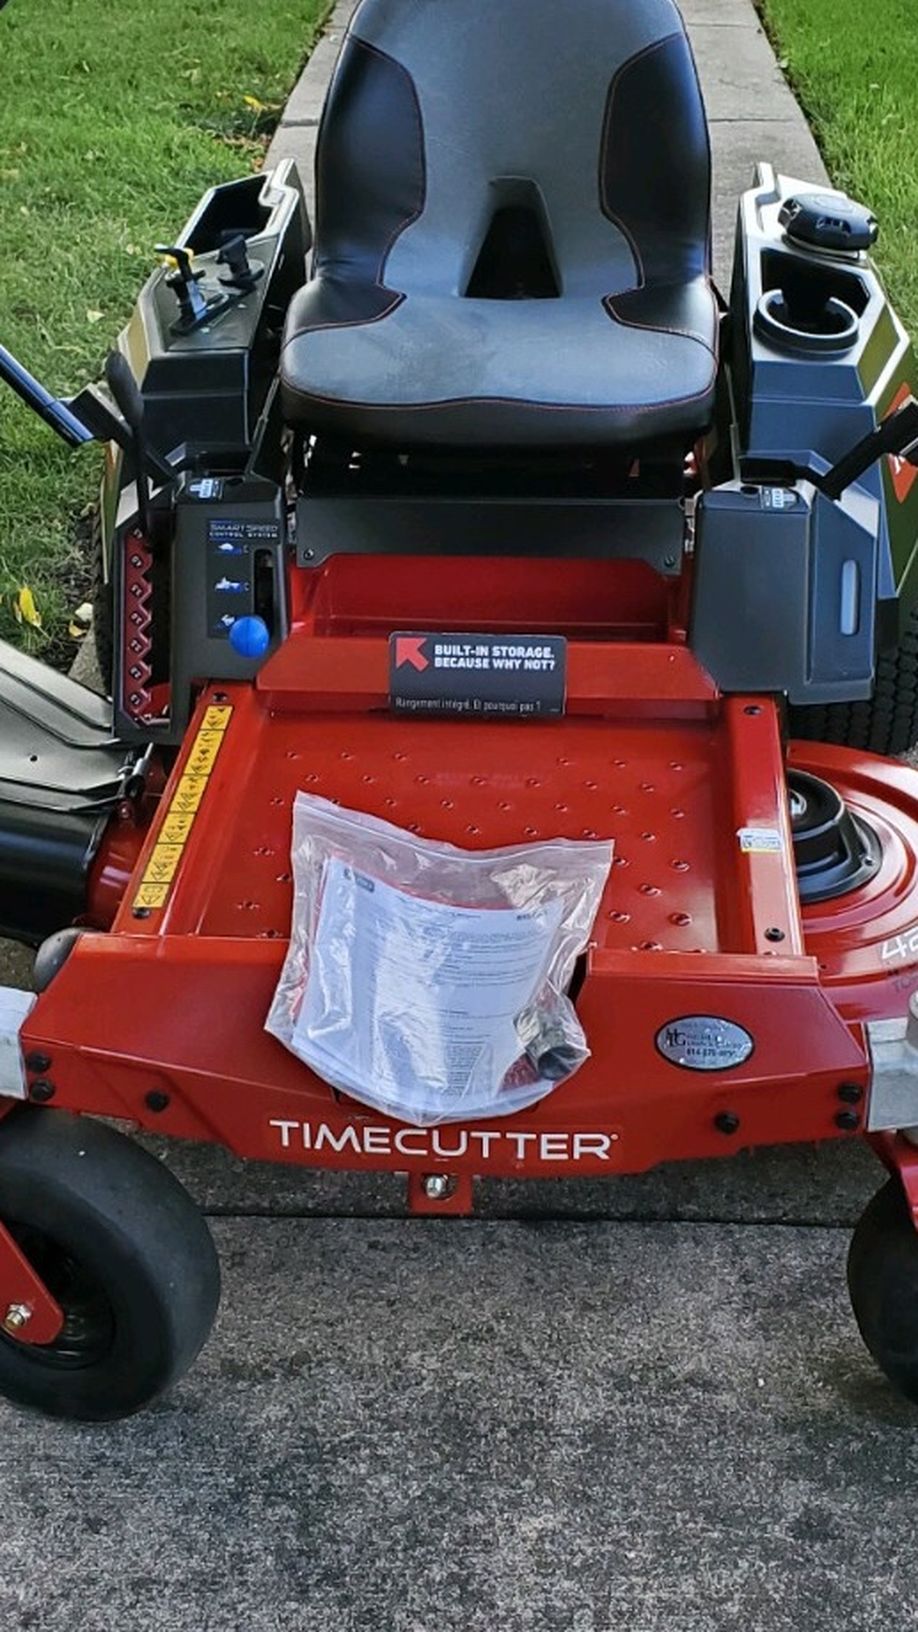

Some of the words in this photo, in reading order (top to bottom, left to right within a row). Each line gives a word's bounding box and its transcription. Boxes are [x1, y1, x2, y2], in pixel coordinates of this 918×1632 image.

[434, 644, 489, 656] BUILT-IN
[492, 646, 555, 659] STORAGE.
[434, 656, 490, 669] BECAUSE
[492, 658, 522, 670] WHY
[523, 659, 555, 671] NOT?
[269, 1119, 612, 1161] TIMECUTTER
